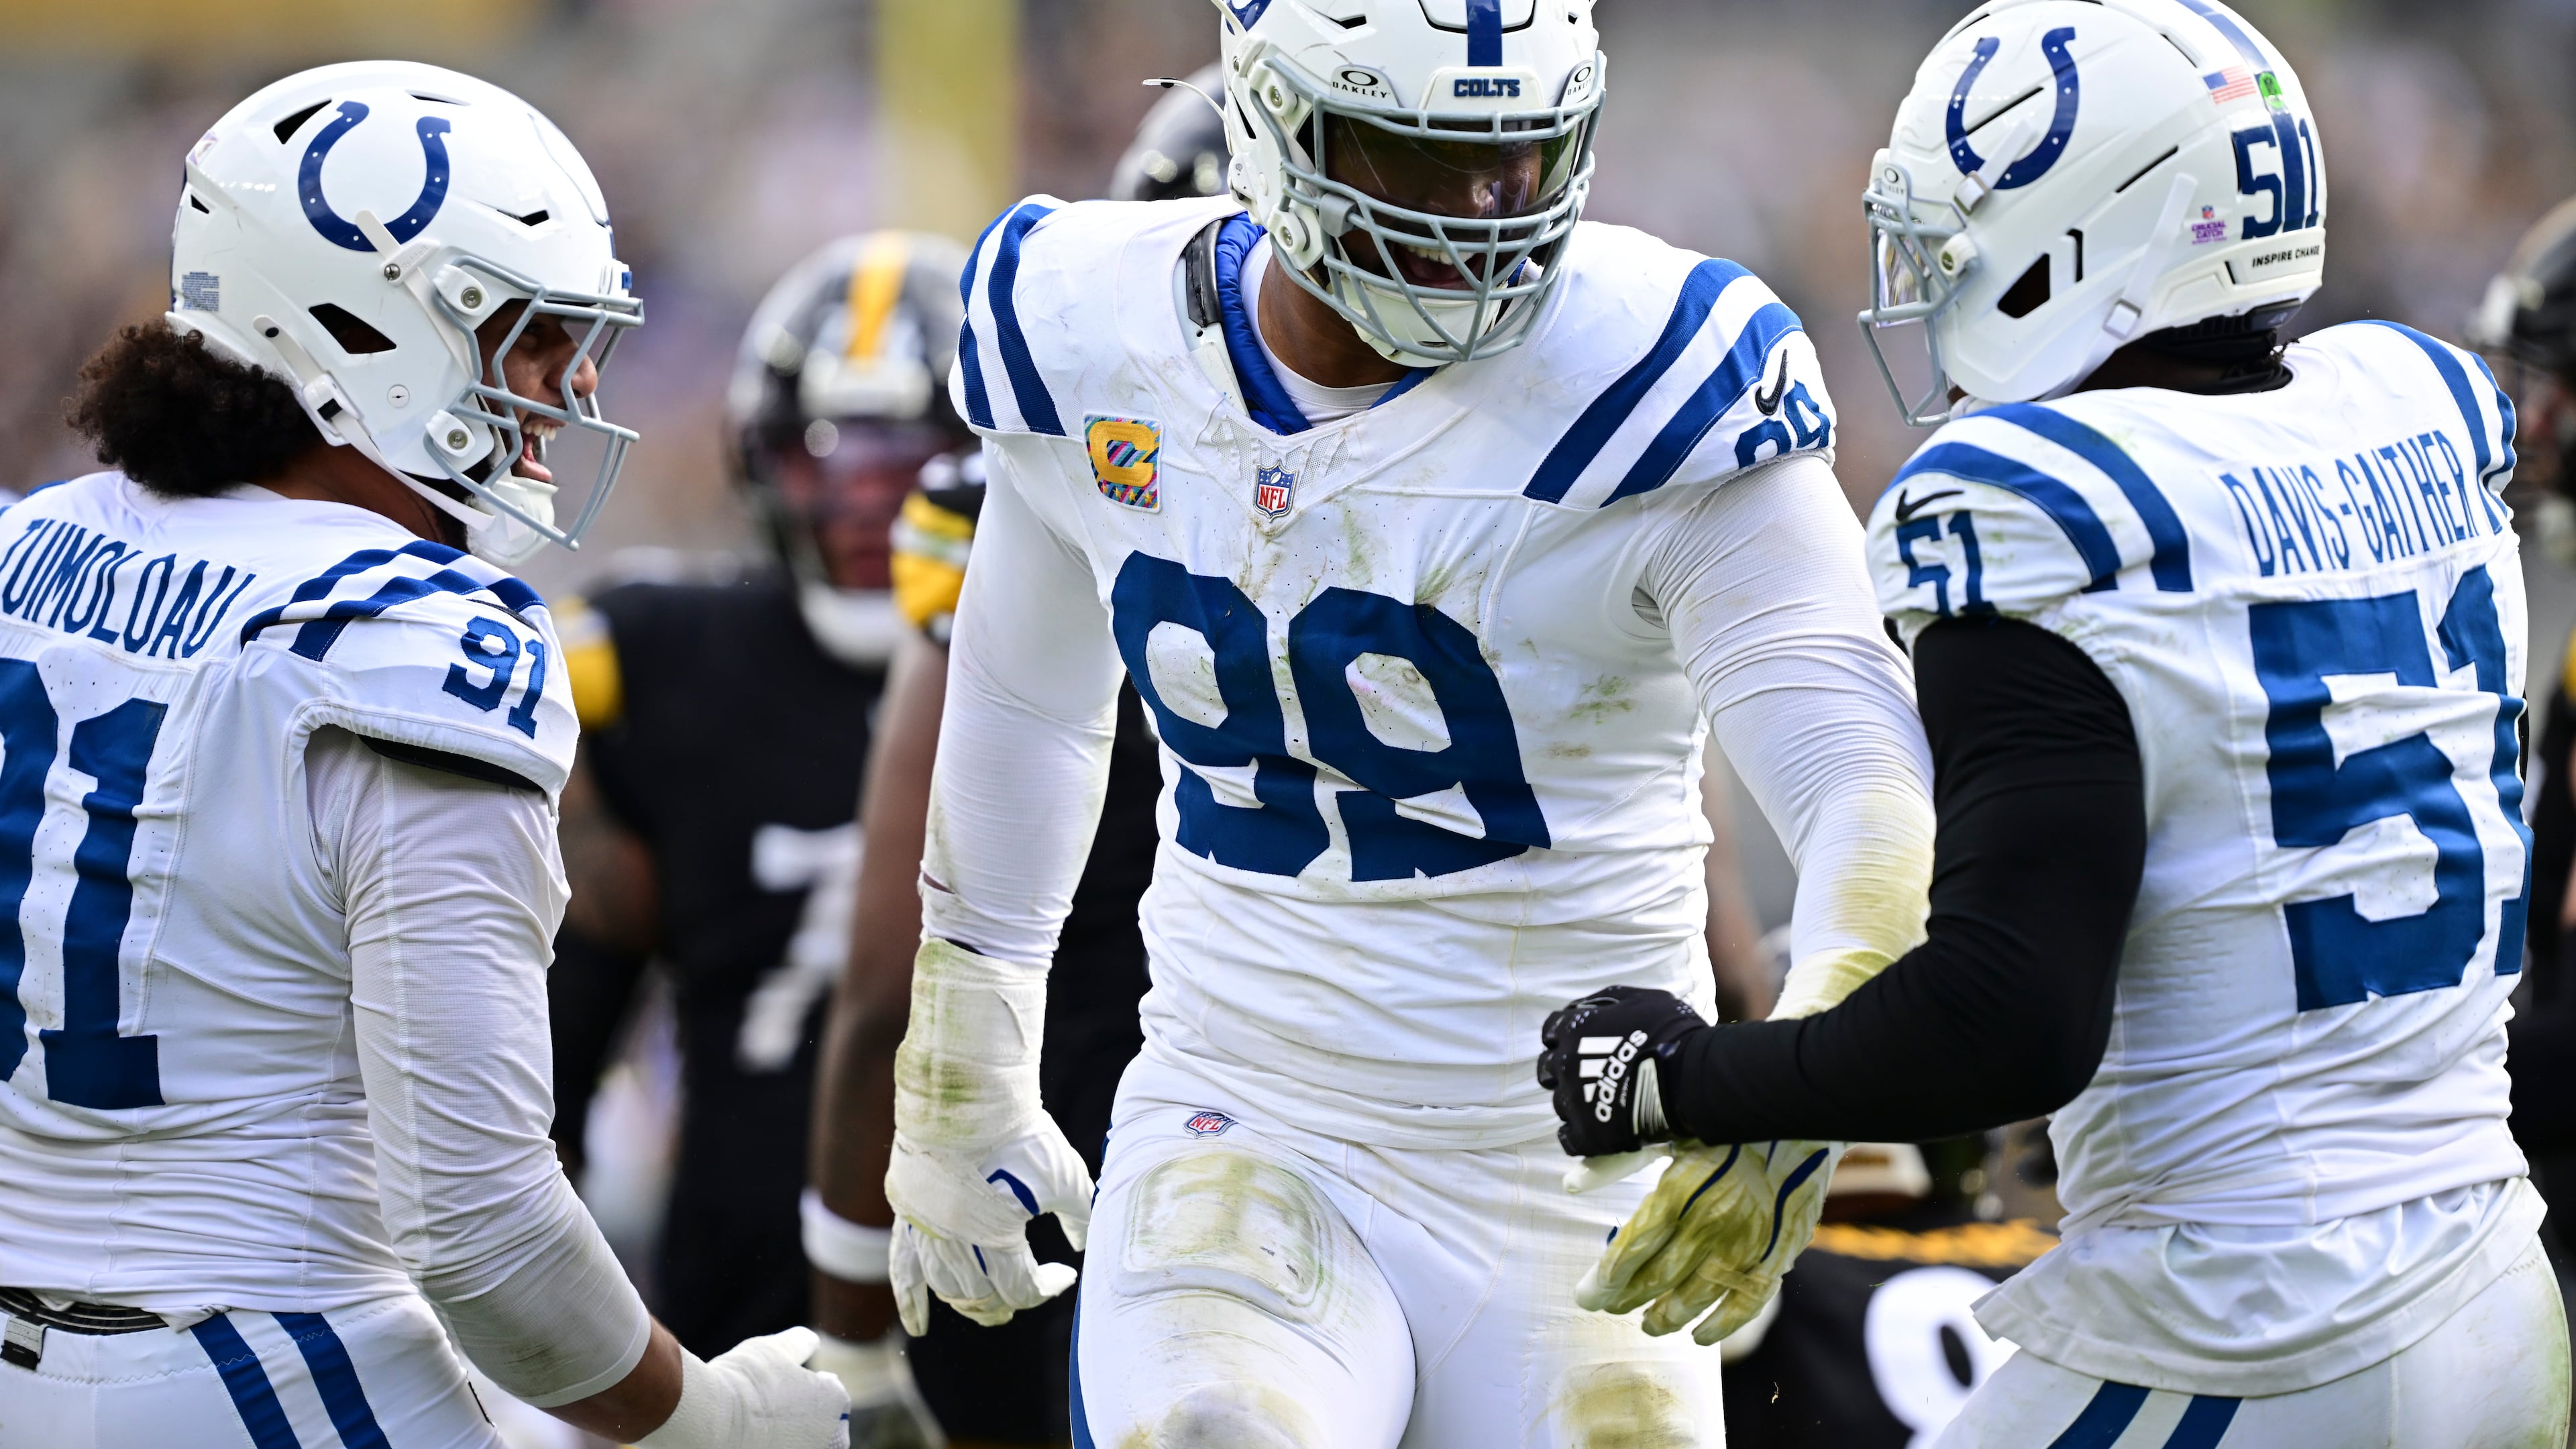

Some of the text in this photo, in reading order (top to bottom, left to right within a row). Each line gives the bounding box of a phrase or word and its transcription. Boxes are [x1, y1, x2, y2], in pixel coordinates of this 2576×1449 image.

[1332, 81, 1387, 98] OAKLEY
[1454, 78, 1520, 97] COLTS
[2232, 118, 2318, 240] 51
[2252, 245, 2320, 268] INSPIRE CHANGE
[1089, 421, 1156, 487] C
[1258, 485, 1286, 511] NFL
[1896, 510, 2000, 619] 51
[442, 615, 546, 740] 91
[1111, 549, 1551, 882] 99
[2249, 564, 2534, 1012] 51
[1595, 1029, 1648, 1123] adidas
[1189, 1117, 1222, 1130] NFL
